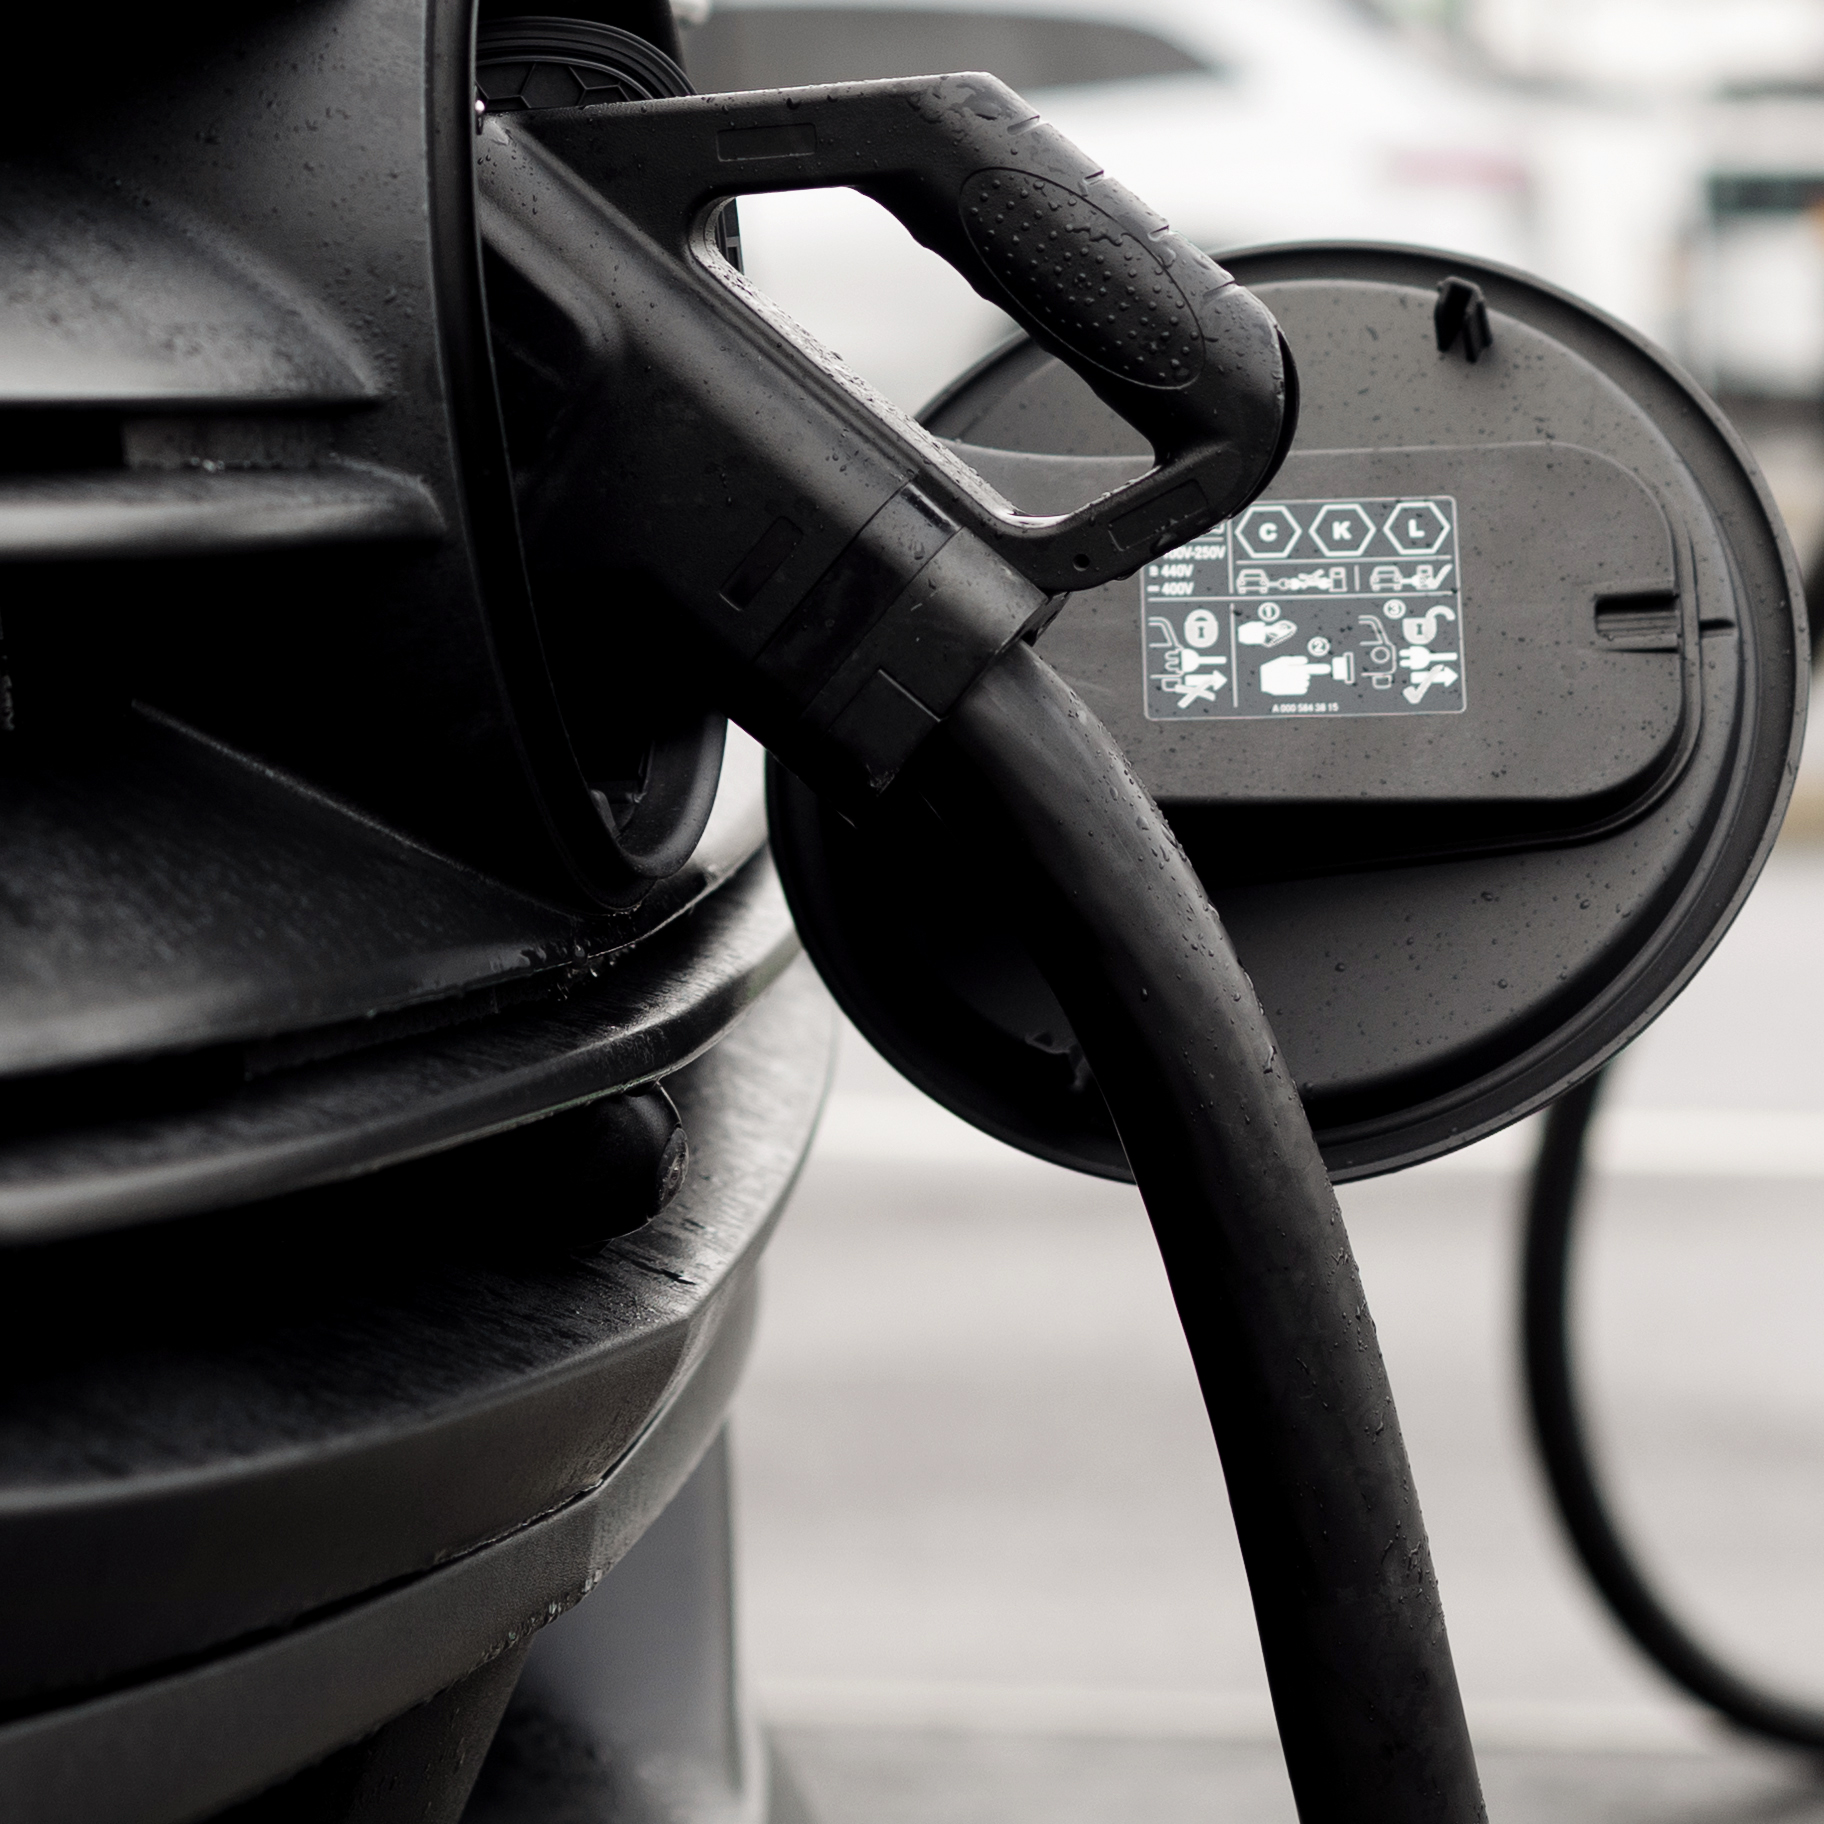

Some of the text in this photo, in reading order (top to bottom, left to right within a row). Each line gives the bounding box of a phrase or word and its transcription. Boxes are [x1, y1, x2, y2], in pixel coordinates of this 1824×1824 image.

[1258, 518, 1425, 542] C K L
[1161, 582, 1194, 595] 400V
[1271, 704, 1279, 713] A
